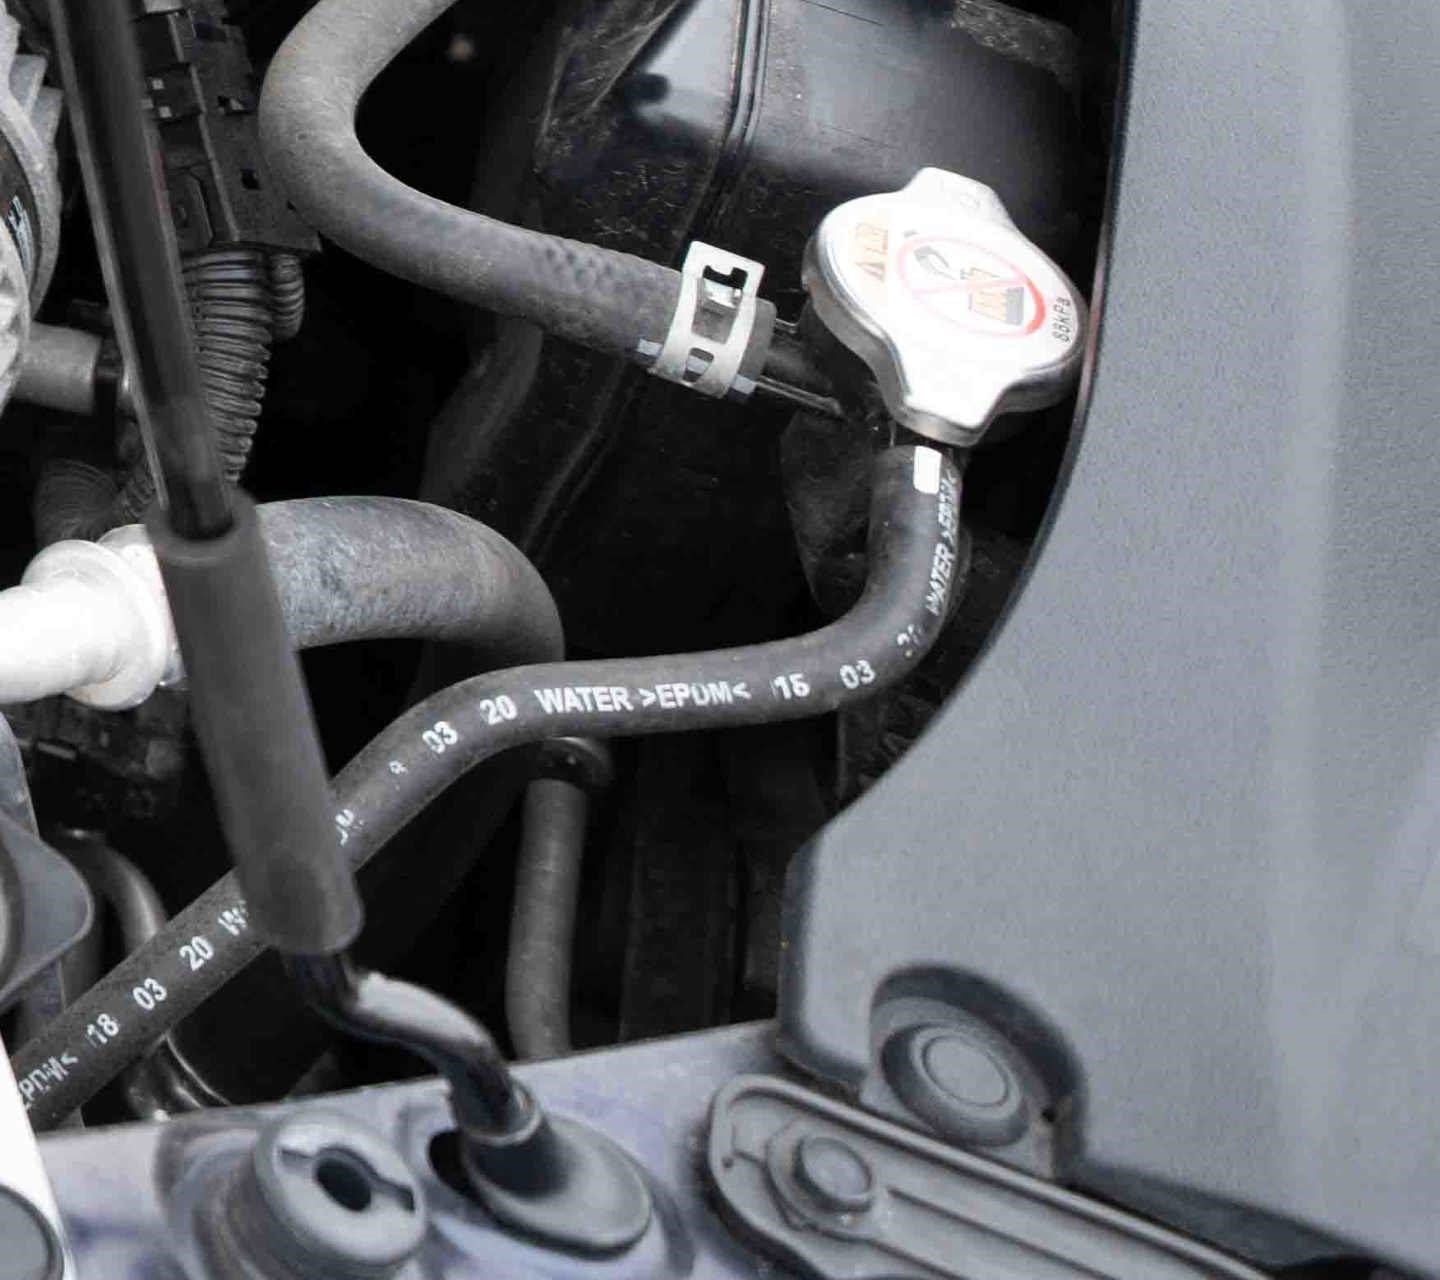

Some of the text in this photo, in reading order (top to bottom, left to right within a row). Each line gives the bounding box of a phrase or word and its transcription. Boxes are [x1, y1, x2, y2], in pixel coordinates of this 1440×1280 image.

[422, 721, 458, 755] 03
[482, 694, 517, 726] 20
[535, 686, 633, 714] WATER
[840, 659, 876, 690] 03
[131, 977, 168, 1011] 03
[179, 935, 215, 972] 20
